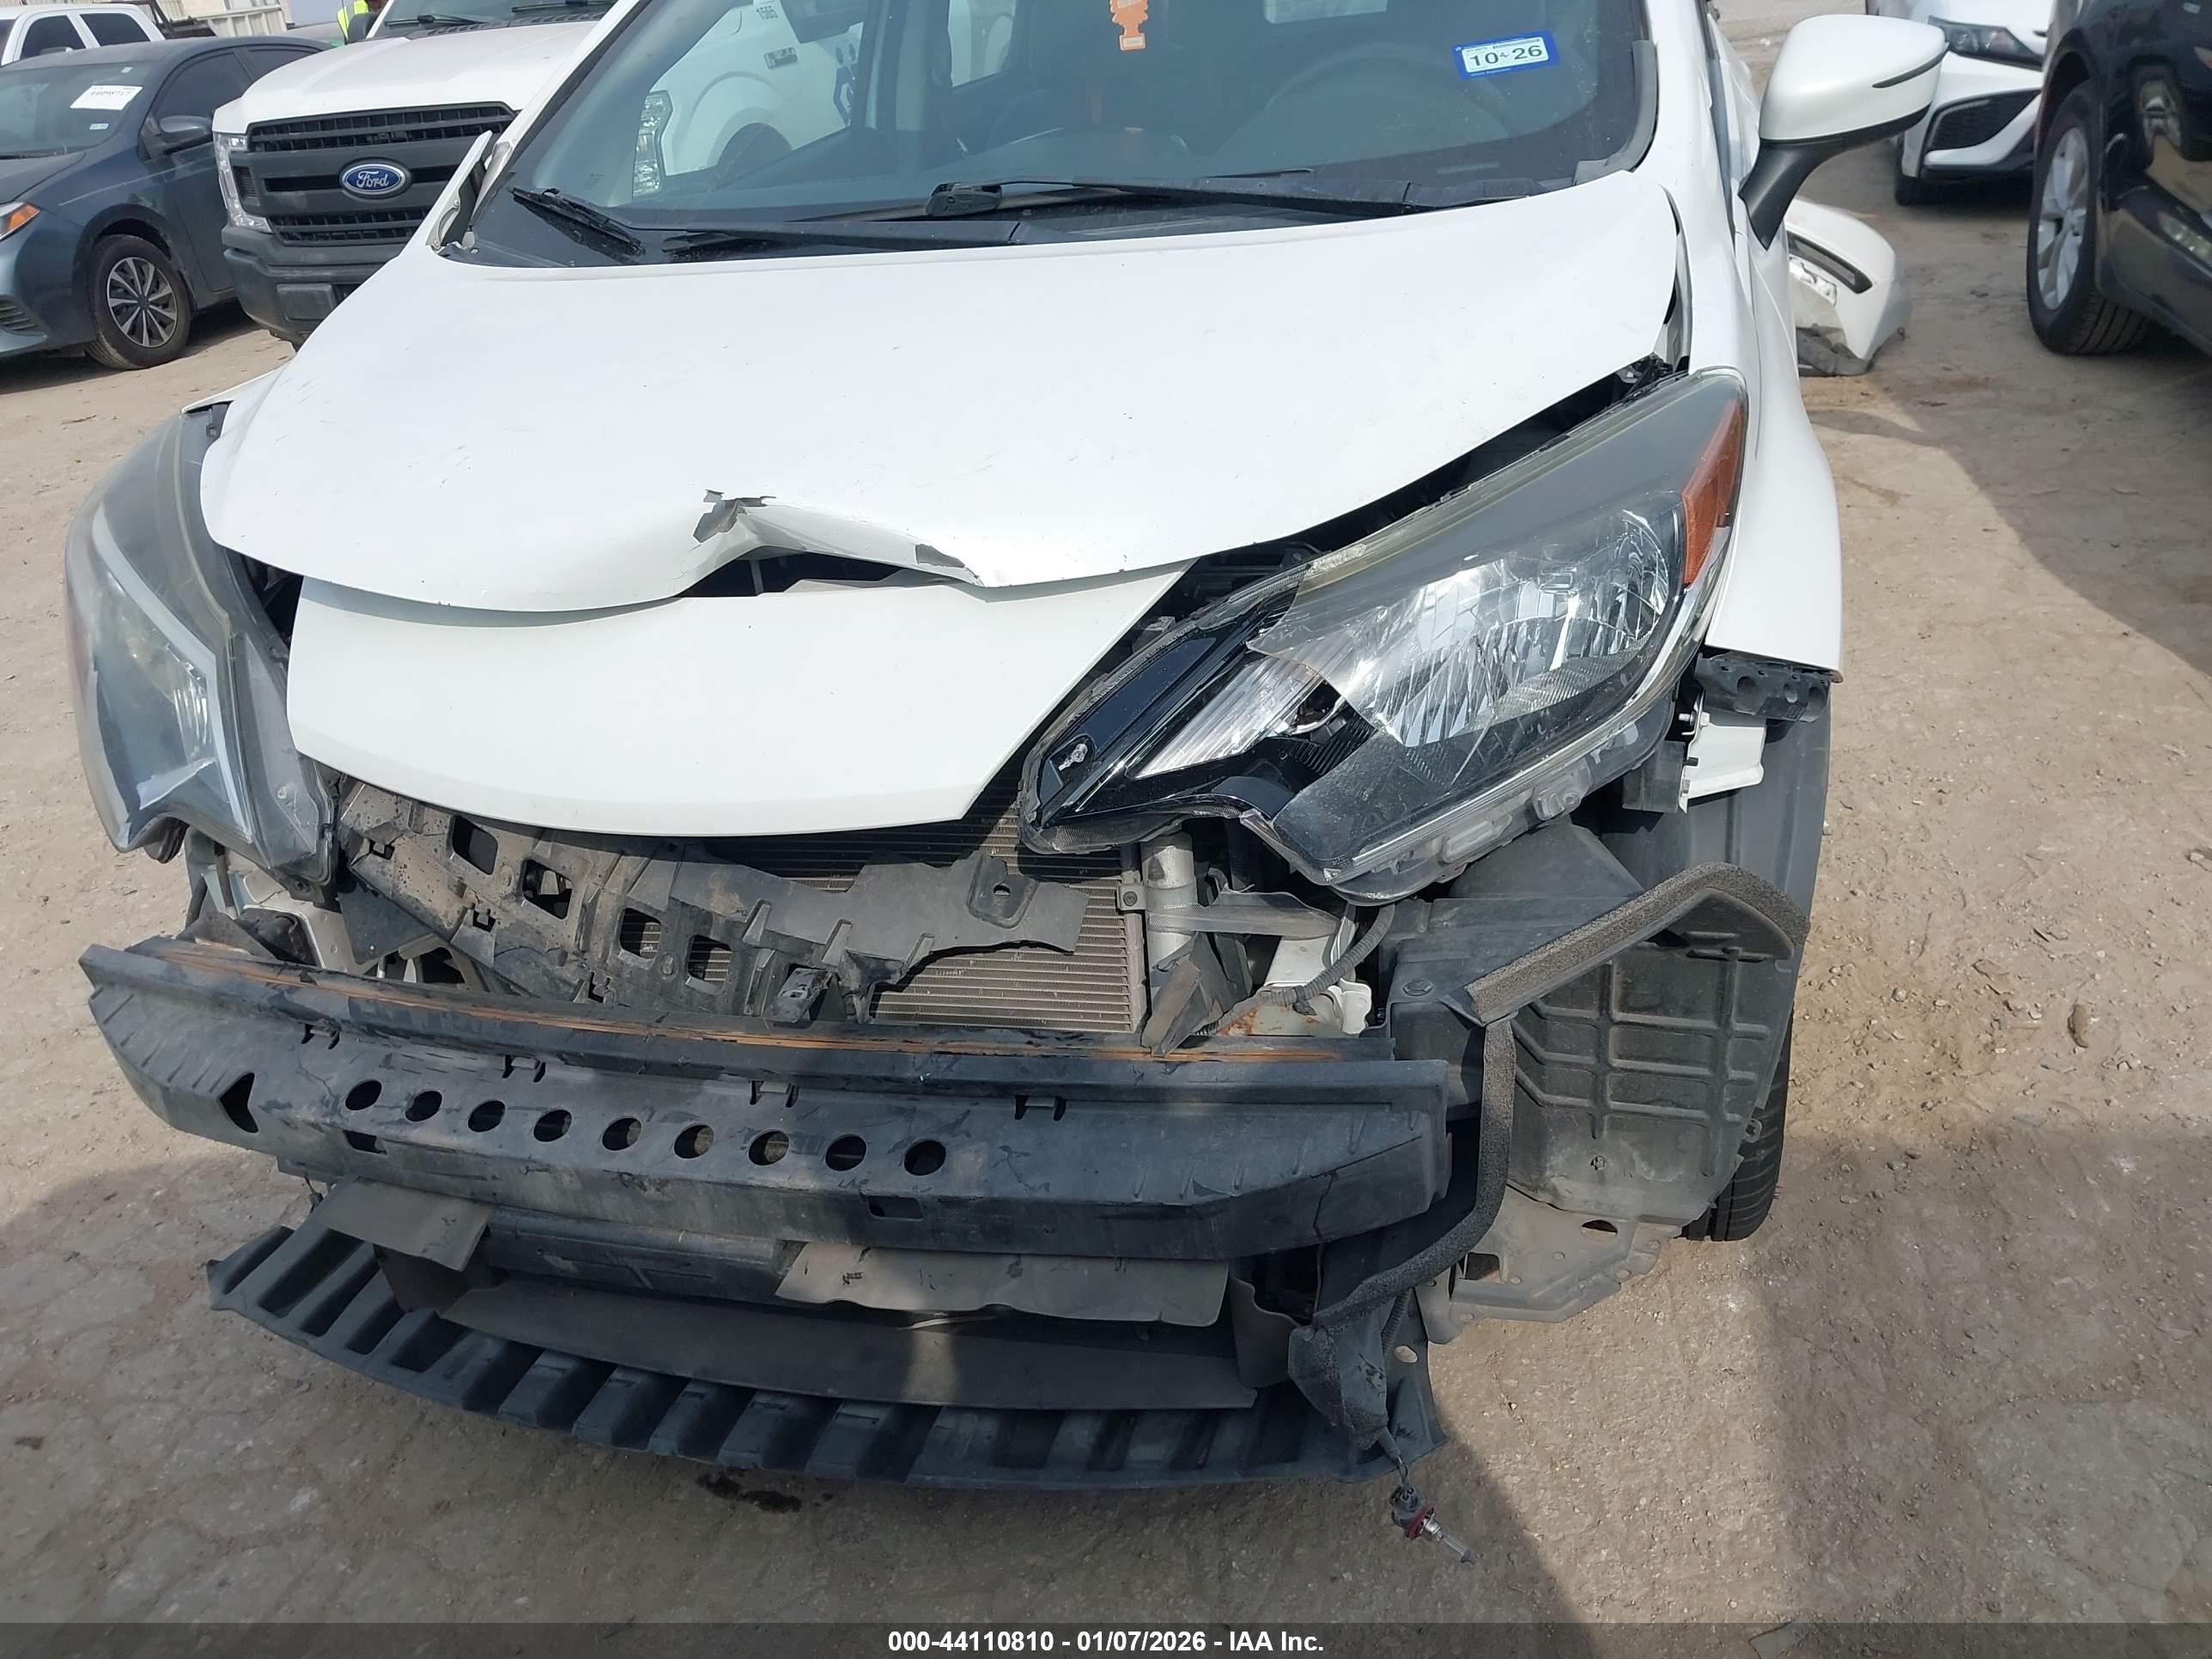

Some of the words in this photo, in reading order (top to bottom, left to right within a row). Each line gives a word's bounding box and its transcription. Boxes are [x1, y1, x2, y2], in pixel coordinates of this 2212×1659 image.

[1469, 52, 1499, 67] 10
[1511, 45, 1543, 61] 26
[356, 170, 390, 188] Ford
